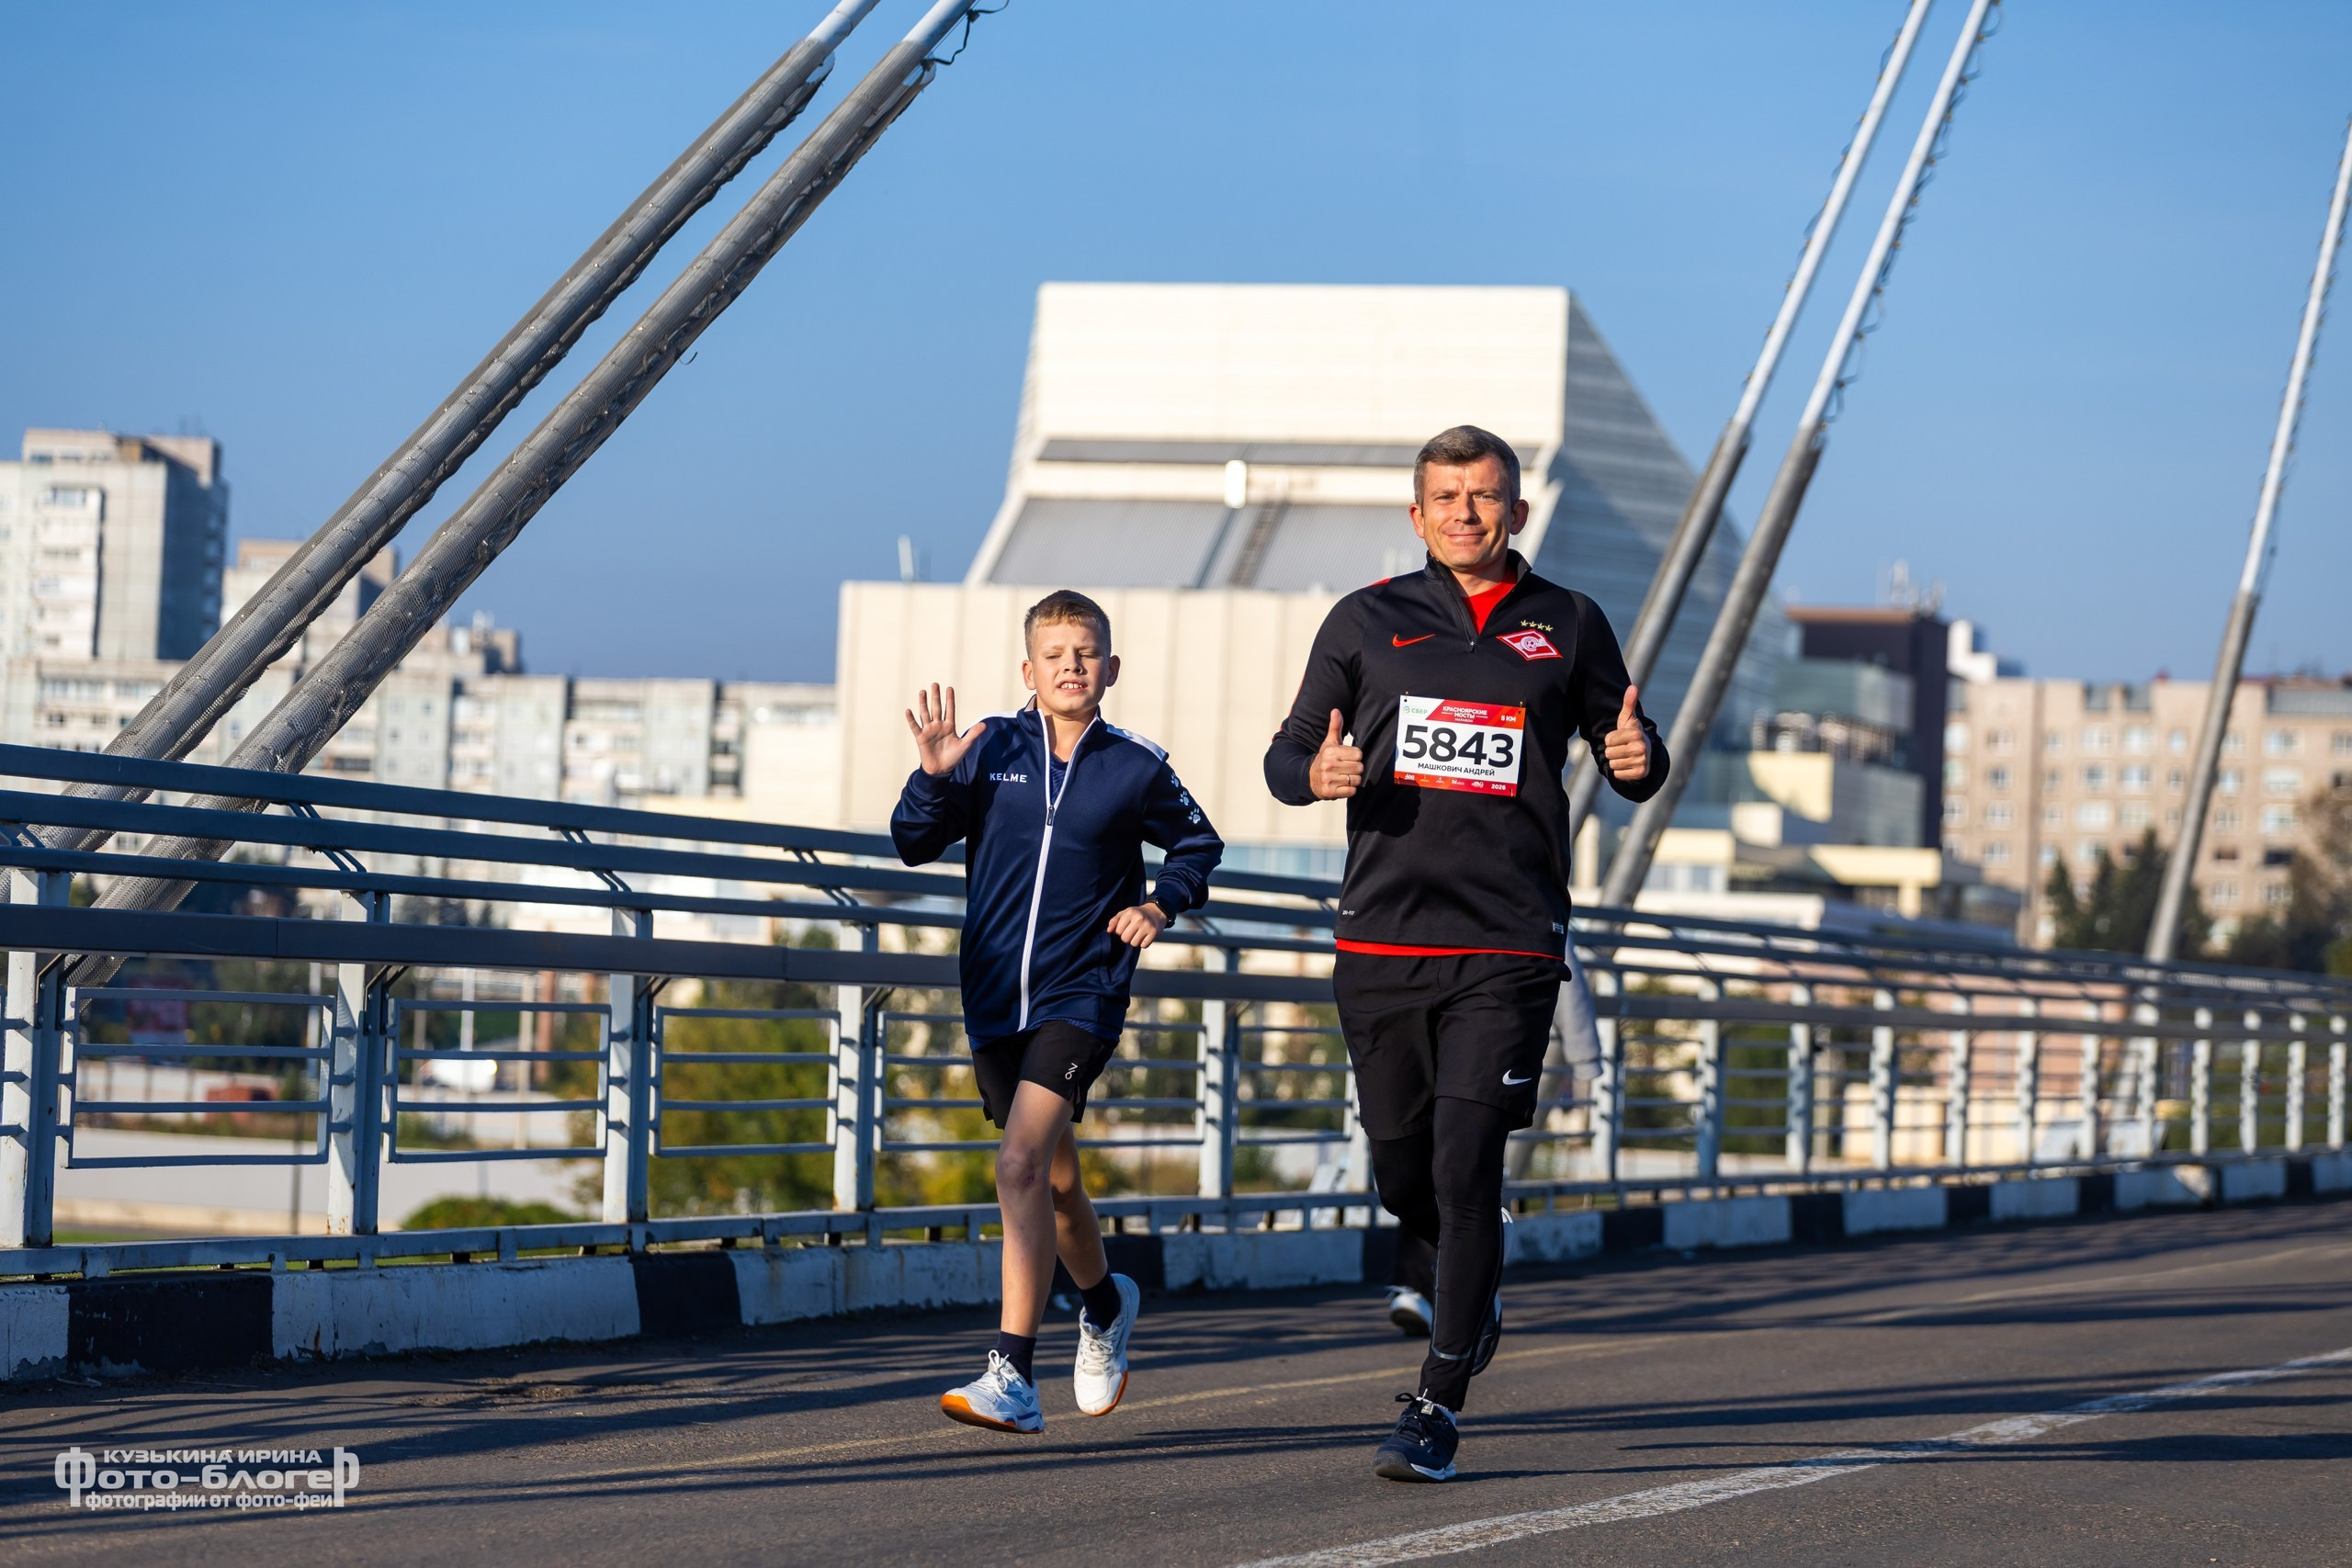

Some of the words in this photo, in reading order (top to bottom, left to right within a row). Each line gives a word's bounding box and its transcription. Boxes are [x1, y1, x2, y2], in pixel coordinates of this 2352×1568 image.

[1442, 705, 1487, 716] КРАСНОЯРСКИЕ
[1402, 724, 1514, 768] 5843
[1418, 762, 1463, 773] МАШКОВИЧ
[1463, 767, 1496, 776] АНДРЕЙ
[989, 773, 1027, 784] KELME
